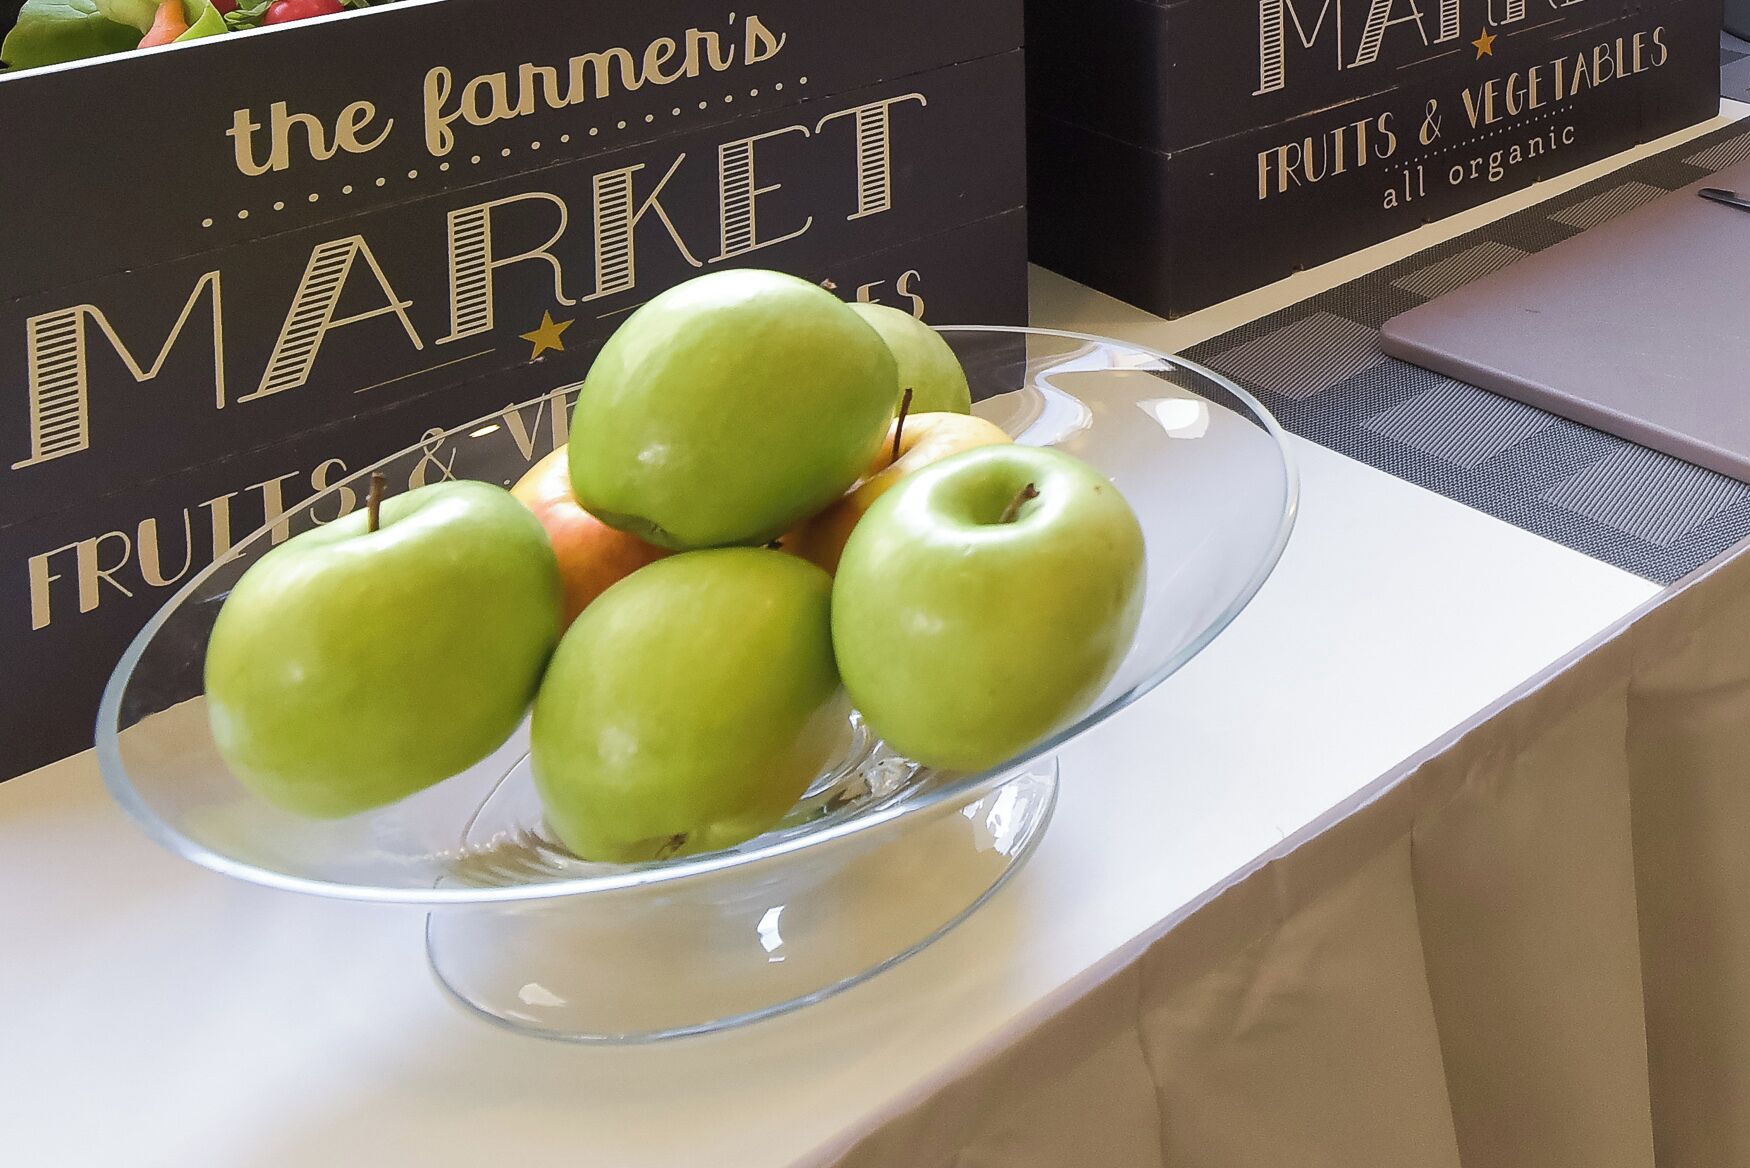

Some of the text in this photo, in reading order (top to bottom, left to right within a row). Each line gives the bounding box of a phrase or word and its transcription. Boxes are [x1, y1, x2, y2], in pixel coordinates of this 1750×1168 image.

[225, 10, 787, 177] the farmer's
[1257, 26, 1668, 200] FRUITS & VEGETABLES
[1383, 122, 1576, 209] all organic
[11, 92, 928, 471] MARKET
[29, 456, 358, 631] FRUITS
